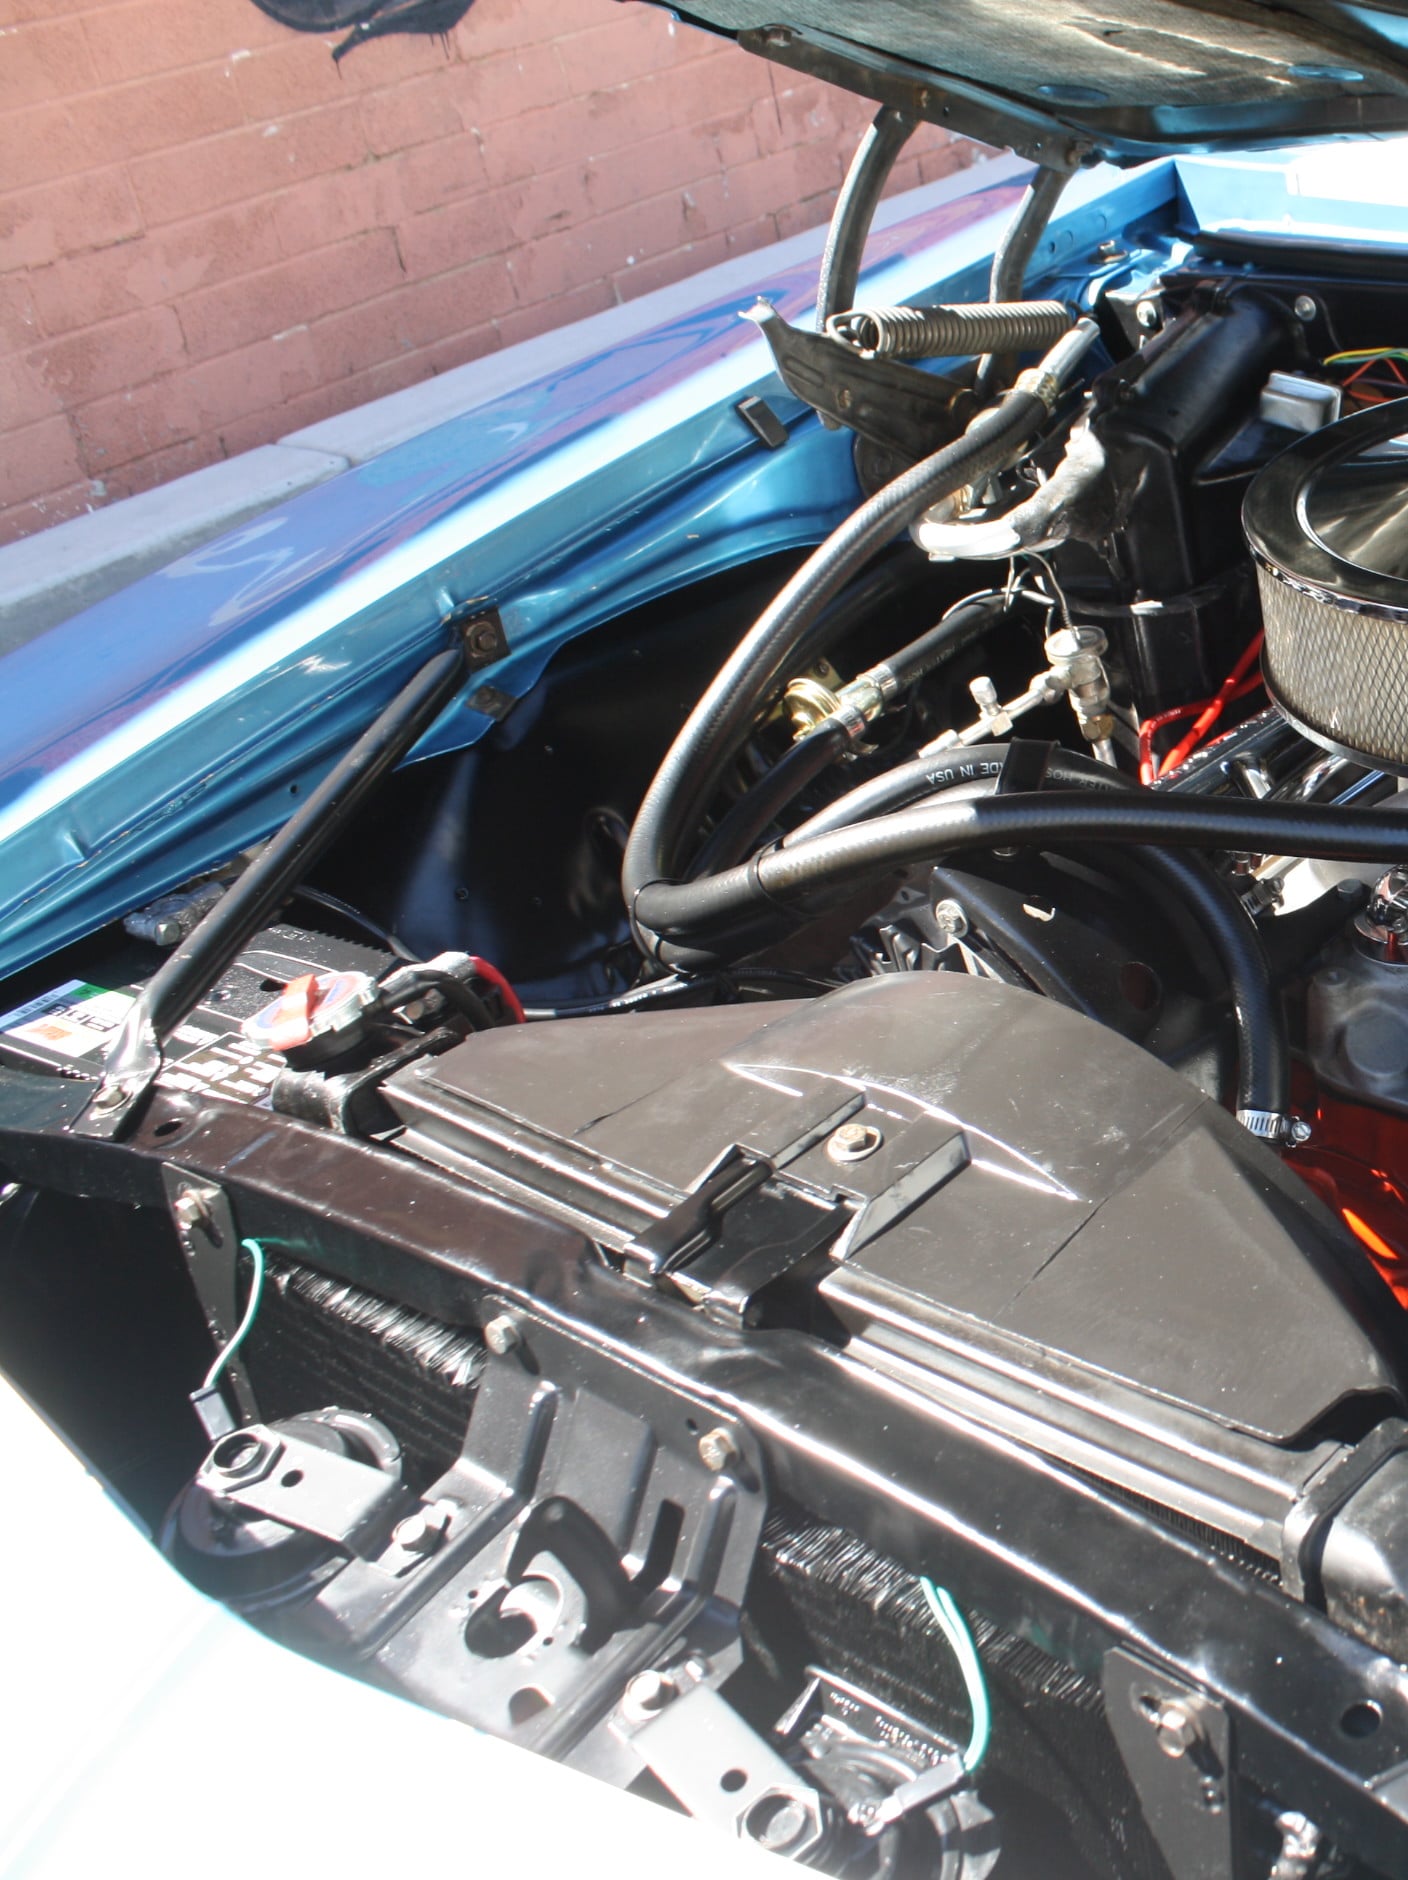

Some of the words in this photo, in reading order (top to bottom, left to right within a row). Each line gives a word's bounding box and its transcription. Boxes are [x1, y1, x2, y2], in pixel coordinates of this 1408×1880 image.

[959, 763, 975, 778] IN
[980, 761, 1004, 775] DE
[925, 768, 955, 785] USA
